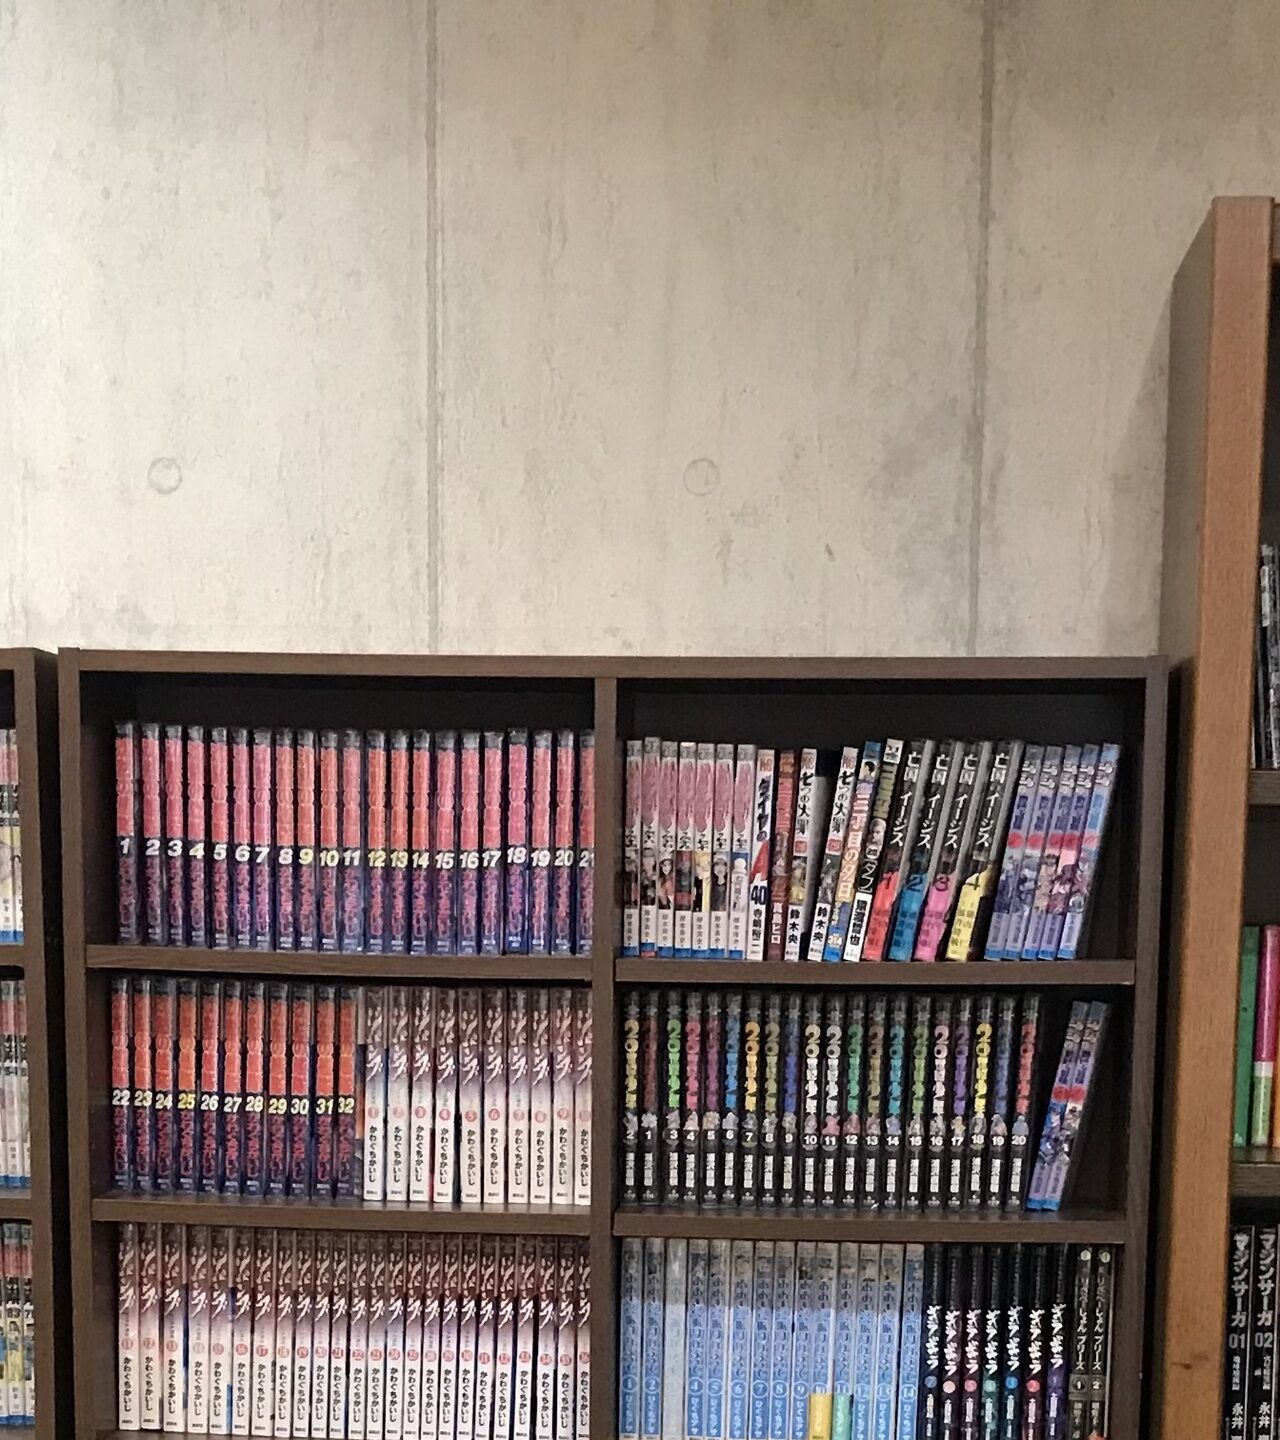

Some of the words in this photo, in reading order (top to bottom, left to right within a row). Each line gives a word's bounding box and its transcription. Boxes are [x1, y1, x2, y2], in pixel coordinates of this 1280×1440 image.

[797, 771, 813, 835] 七つの大罪
[832, 770, 854, 834] 七つの大罪
[121, 838, 130, 854] 1
[146, 840, 160, 855] 2
[168, 840, 183, 856] 3
[189, 843, 205, 859] 4
[214, 844, 227, 860] 5
[235, 845, 250, 861] 6
[255, 847, 270, 863] 7
[279, 848, 293, 864] 8
[299, 848, 314, 864] 9
[320, 851, 339, 866] 10
[343, 850, 360, 866] 11
[368, 852, 386, 867] 12
[391, 852, 408, 867] 13
[412, 852, 429, 868] 14
[435, 853, 454, 869] 15
[460, 852, 478, 868] 16
[482, 851, 501, 866] 17
[507, 847, 526, 863] 18
[531, 850, 550, 866] 19
[554, 850, 574, 866] 20
[580, 850, 594, 867] 21
[908, 875, 923, 892] 2
[935, 875, 949, 891] 3
[968, 875, 980, 891] 4
[751, 886, 768, 904] 40
[789, 909, 800, 944] 鈴木央
[813, 907, 827, 942] 鈴木央
[112, 1090, 130, 1105] 22
[134, 1090, 152, 1106] 23
[156, 1094, 173, 1109] 24
[178, 1093, 195, 1109] 25
[201, 1095, 219, 1111] 26
[224, 1096, 242, 1112] 27
[246, 1096, 264, 1112] 28
[338, 1097, 354, 1113] 32
[269, 1098, 287, 1114] 29
[291, 1098, 309, 1114] 30
[316, 1098, 333, 1114] 31
[369, 1125, 377, 1183] かわぐちかいじ
[440, 1128, 448, 1184] かわぐちかいじ
[559, 1127, 567, 1185] かわぐちかいじ
[1231, 1234, 1249, 1327] マジンサーガ
[1257, 1234, 1275, 1326] マジンサーガ
[926, 1306, 941, 1370] ギラギラ
[1229, 1333, 1245, 1348] 01
[1255, 1332, 1273, 1347] 02
